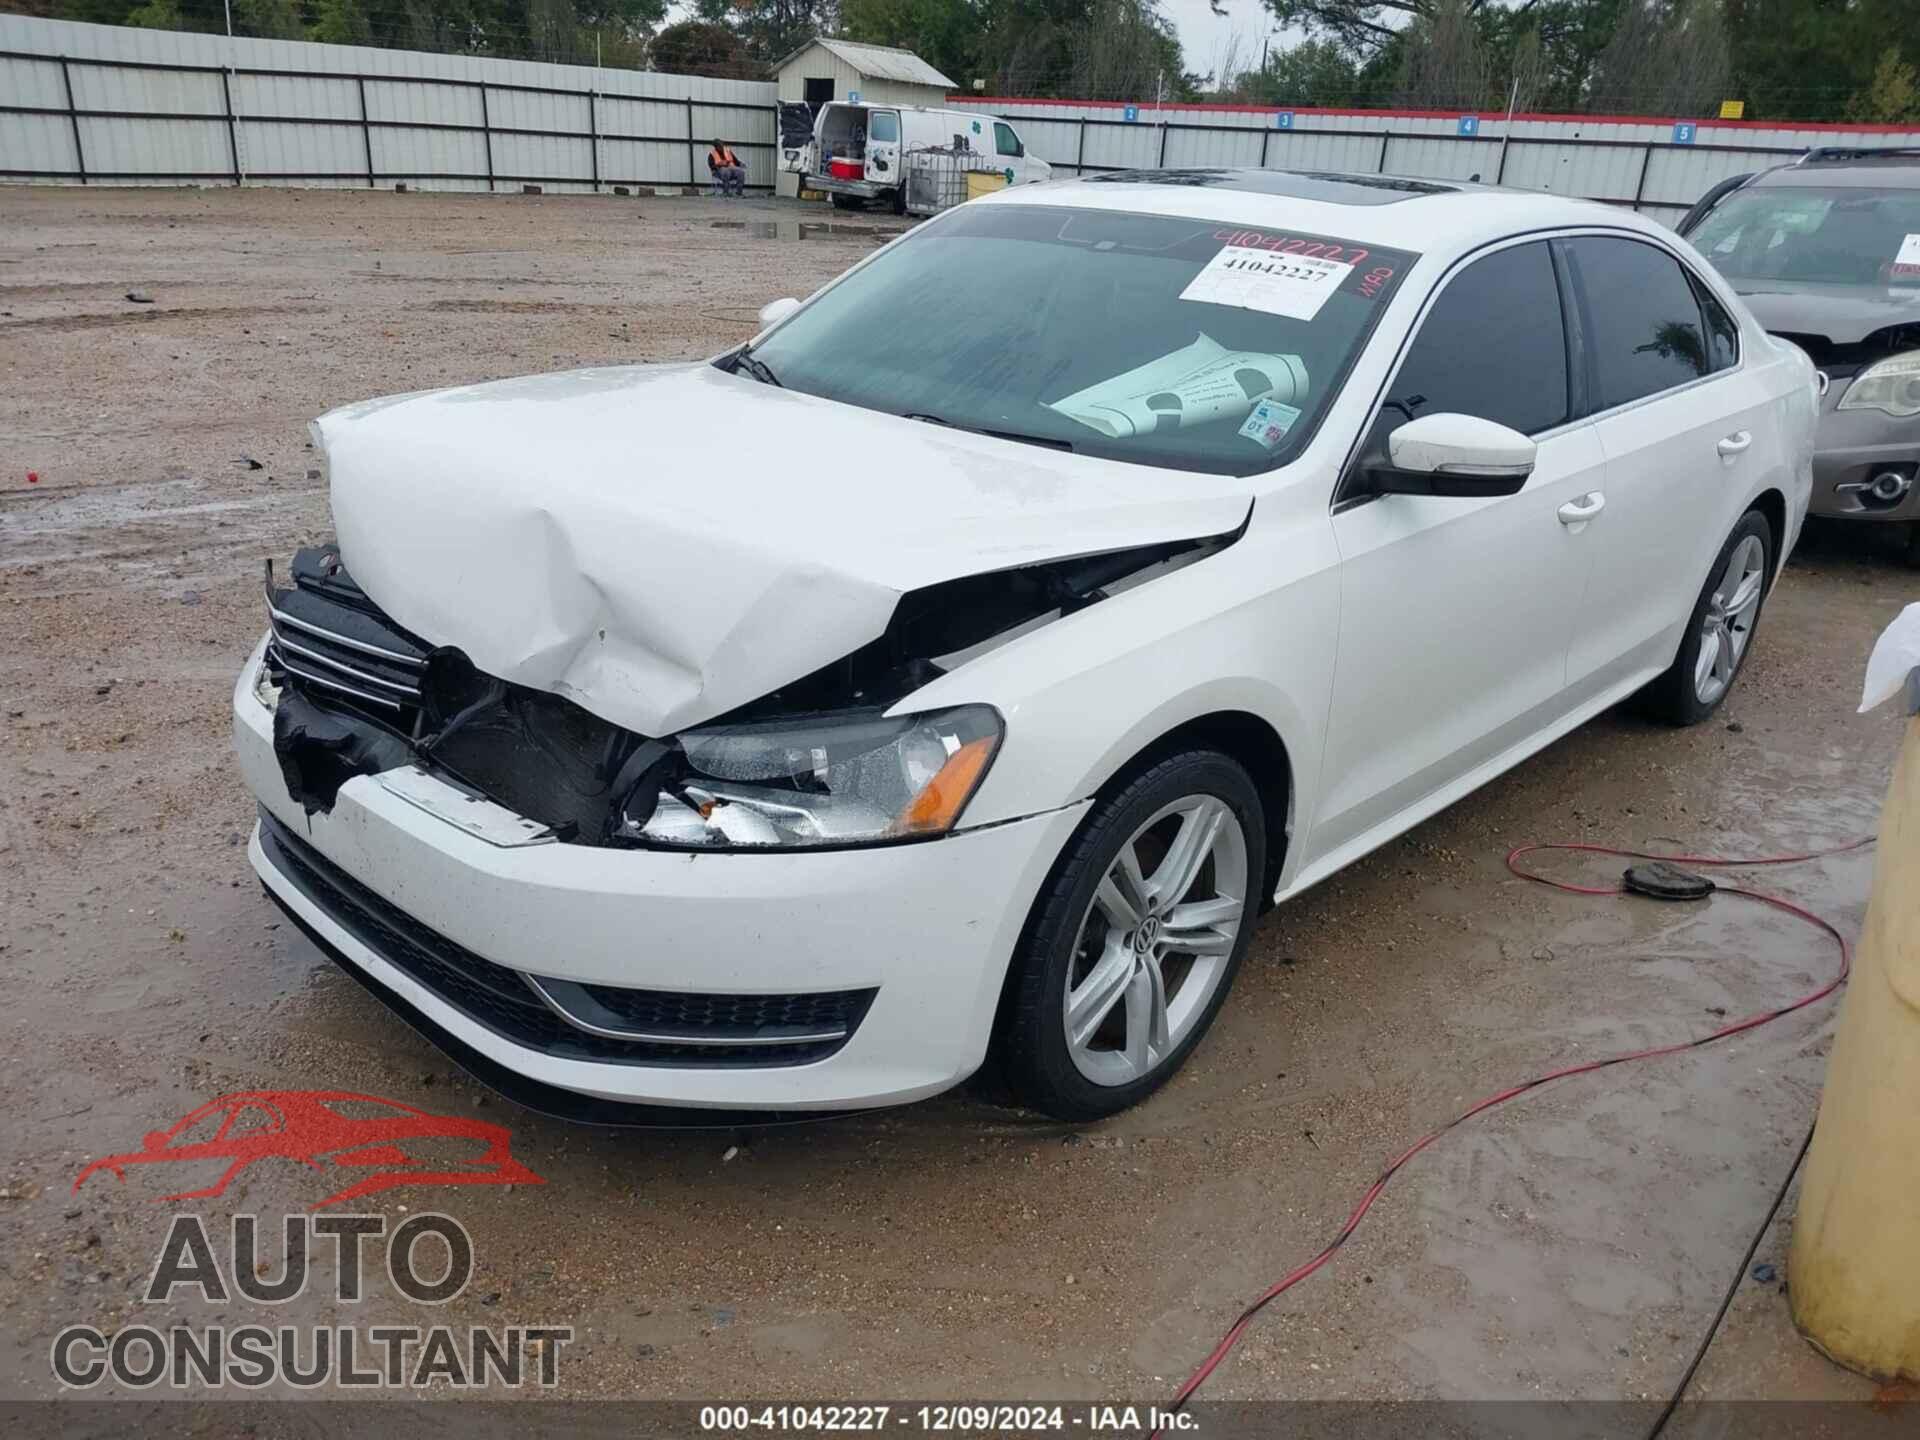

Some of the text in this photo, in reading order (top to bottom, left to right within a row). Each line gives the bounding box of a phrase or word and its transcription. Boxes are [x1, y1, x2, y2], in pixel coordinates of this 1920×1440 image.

[1464, 119, 1473, 132] 4
[1679, 126, 1689, 140] 5
[1214, 229, 1369, 267] 41042227
[1224, 258, 1329, 282] 41042227
